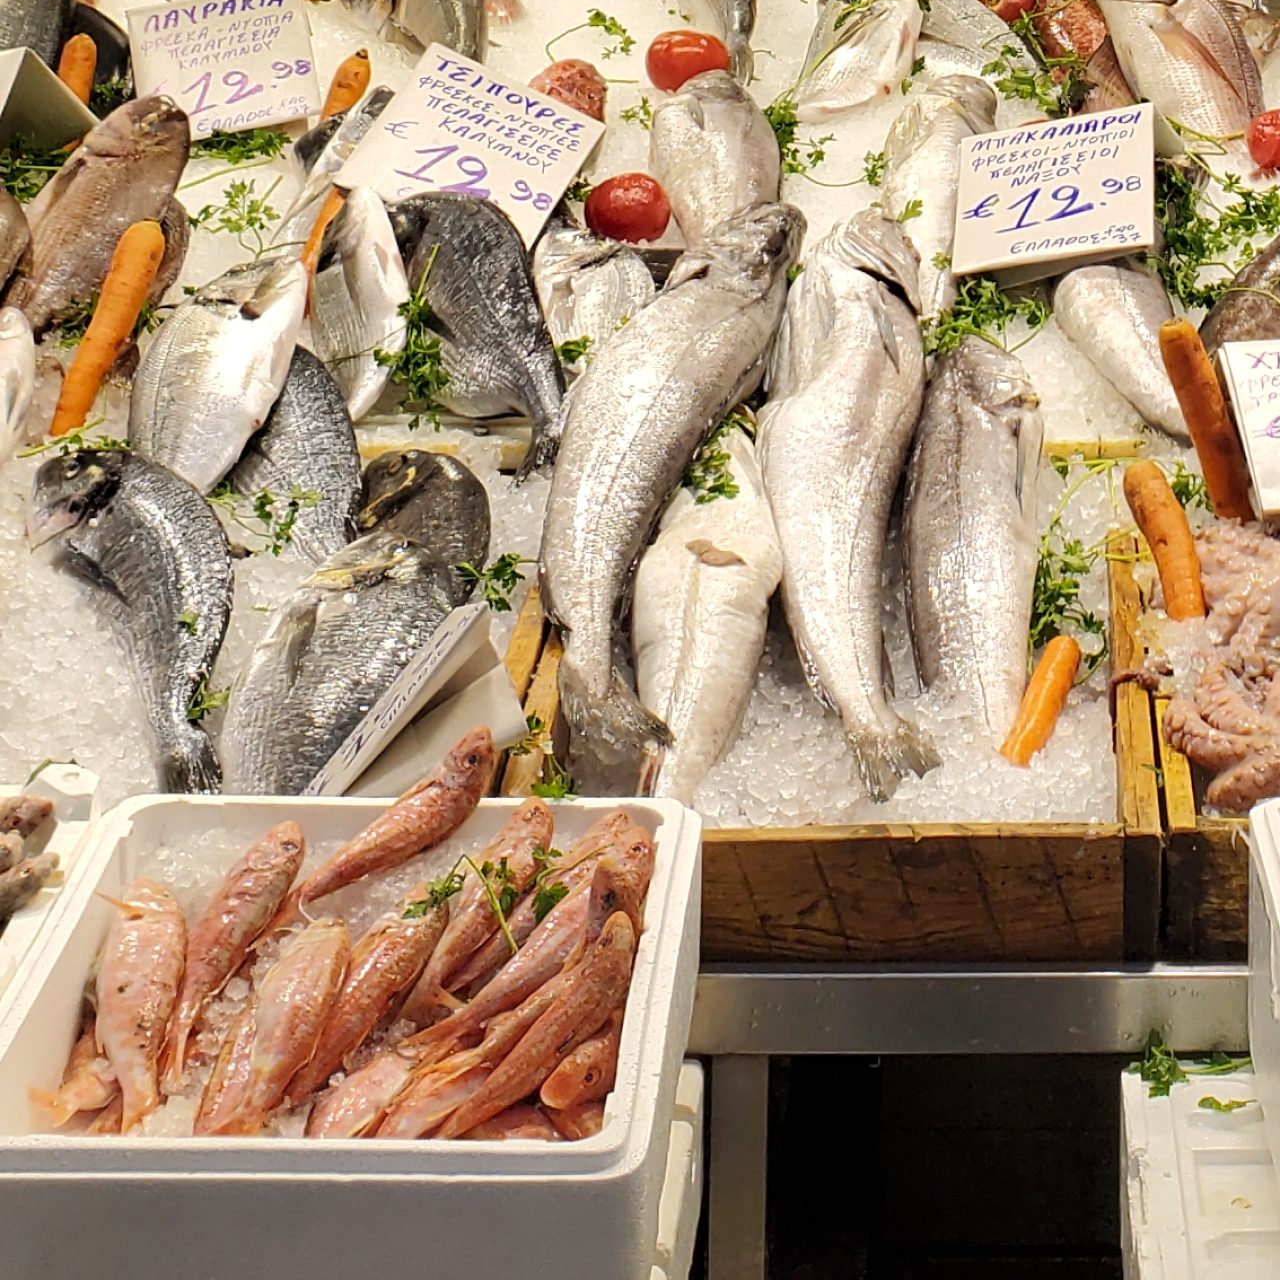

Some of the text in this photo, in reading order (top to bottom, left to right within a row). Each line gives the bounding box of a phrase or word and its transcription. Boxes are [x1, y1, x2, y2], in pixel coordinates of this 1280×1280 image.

[436, 54, 585, 135] ΤΣΙΠΟΥΡΕΣ
[438, 116, 552, 174] ΚΑΛΥΜΝΟΥ
[971, 111, 1142, 152] ΜΠΑΚΑΛΙΑΡΟΙ
[1010, 164, 1083, 188] ΝΑΞΟΥ
